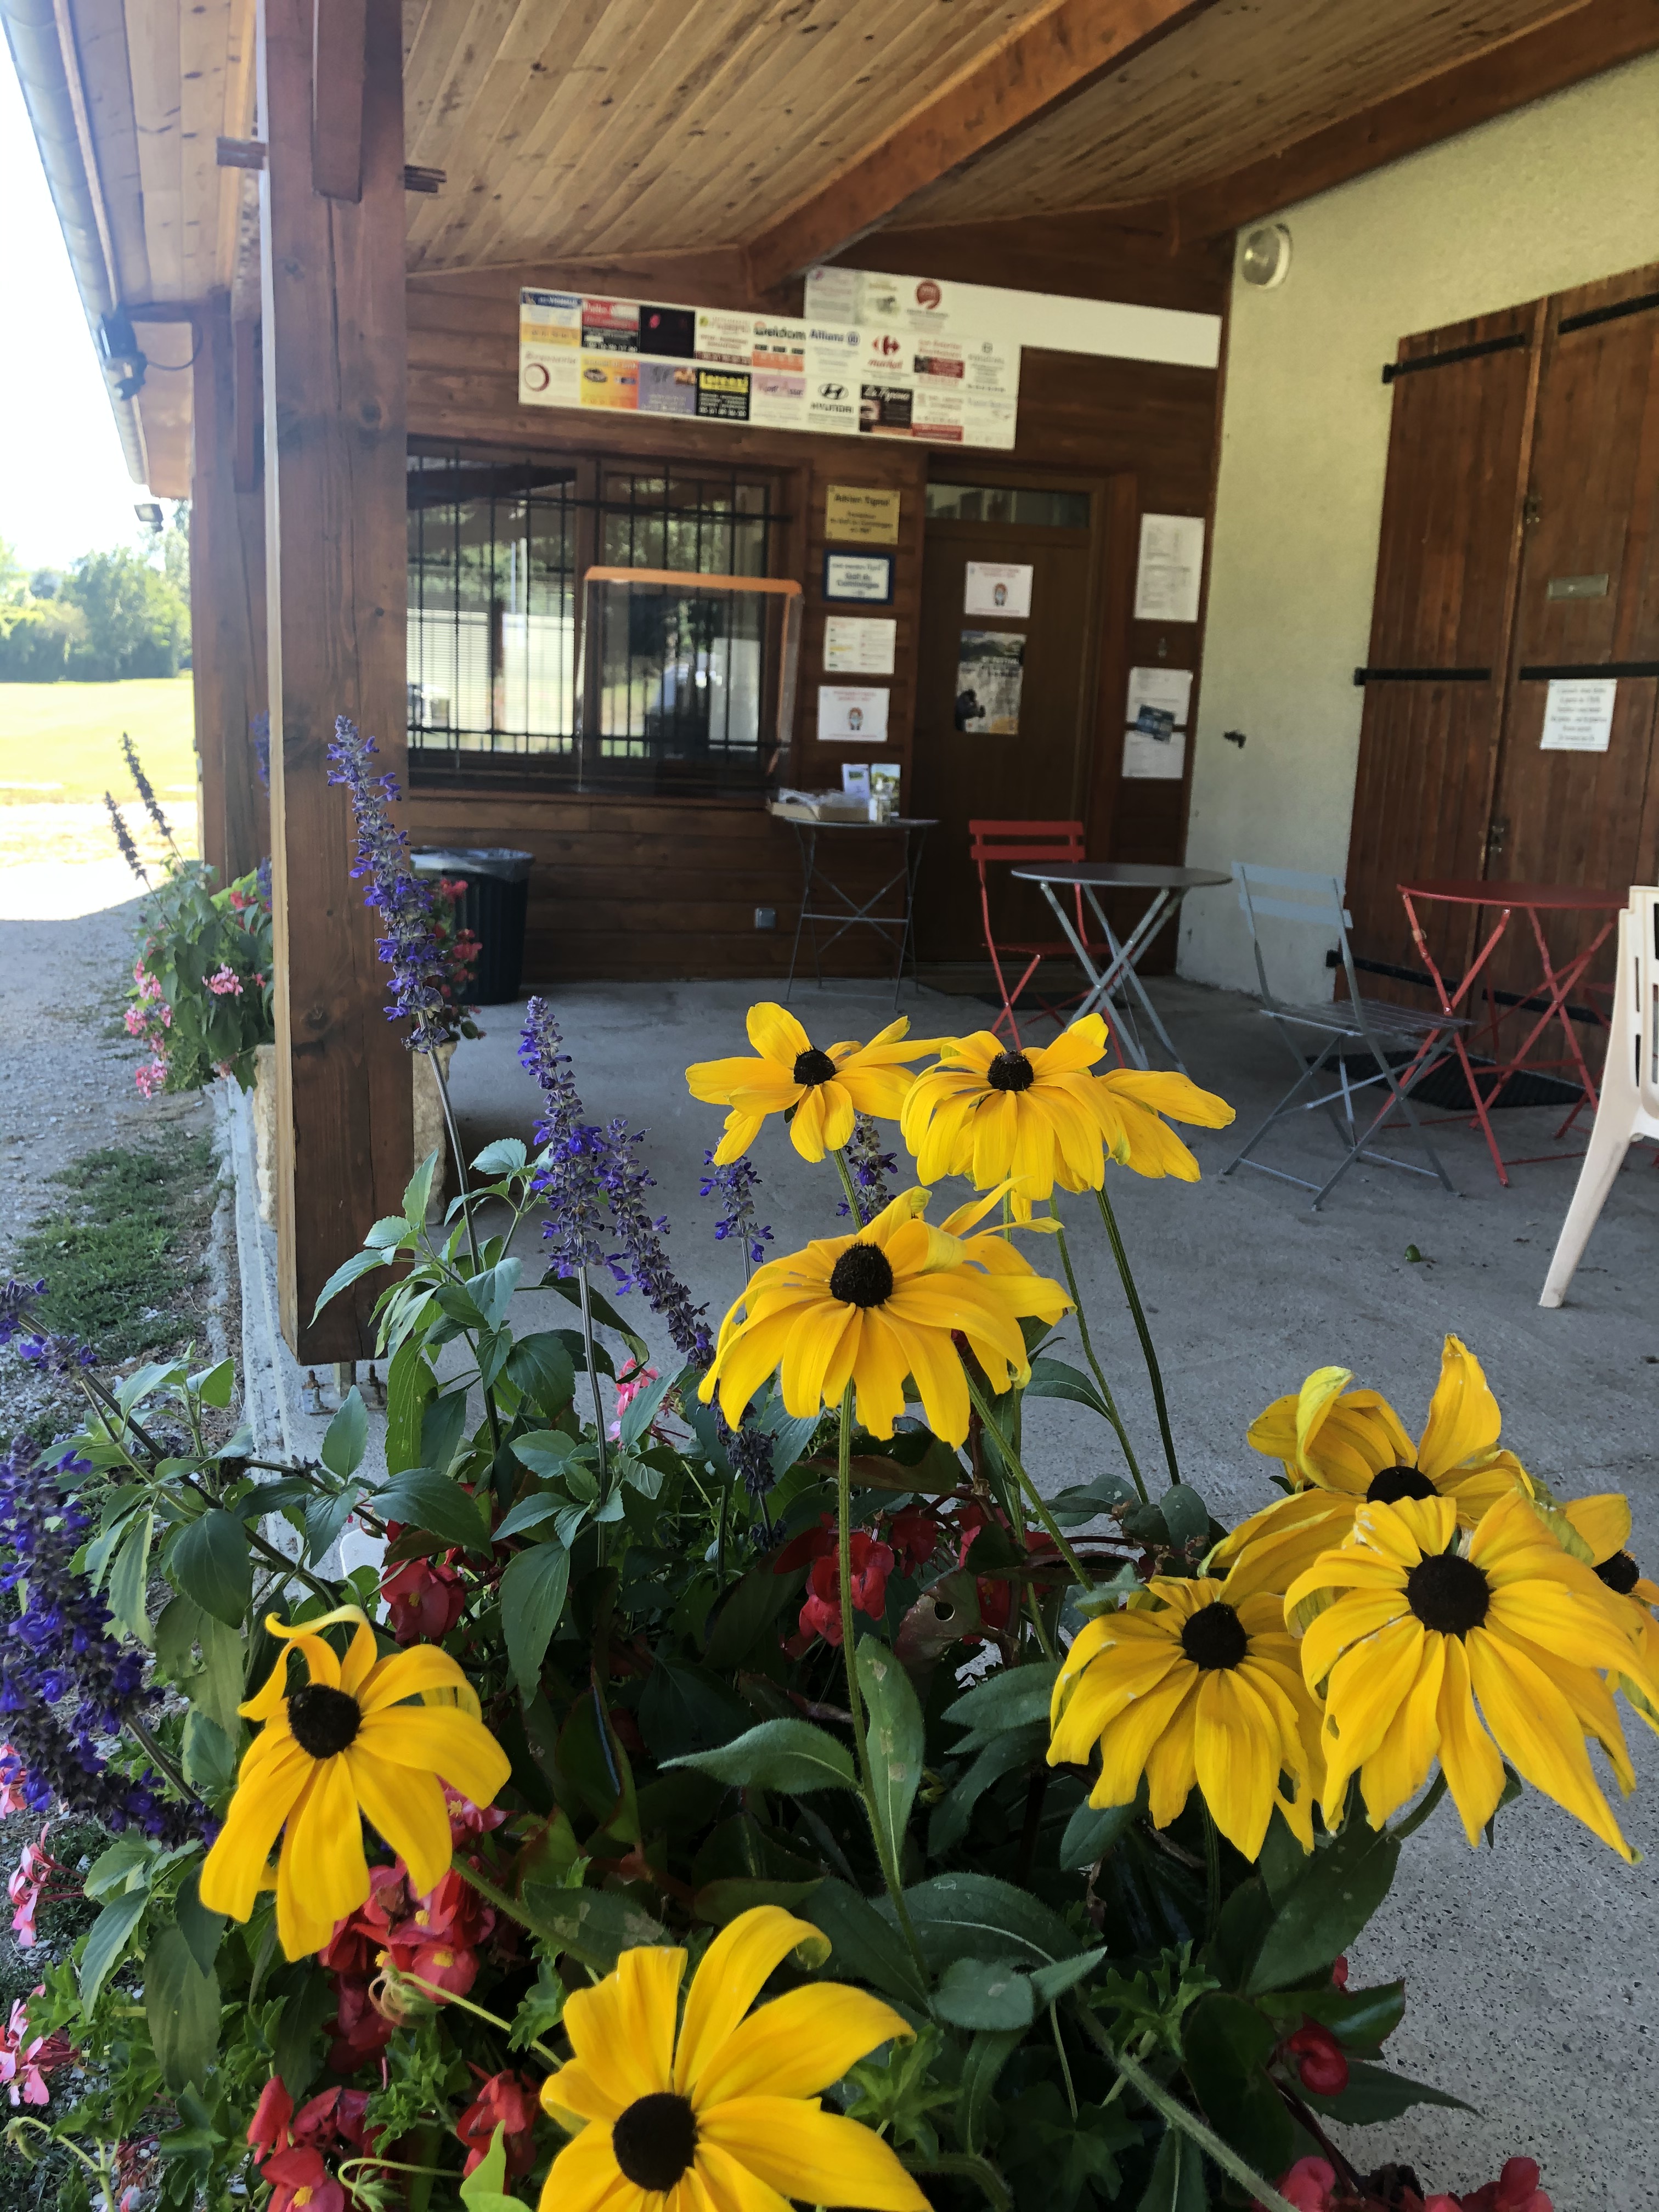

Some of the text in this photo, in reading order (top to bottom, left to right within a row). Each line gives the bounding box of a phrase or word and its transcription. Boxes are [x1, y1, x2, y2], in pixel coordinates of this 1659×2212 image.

[810, 329, 844, 342] Allianz
[868, 359, 904, 370] market
[810, 402, 854, 414] HYUNDAI
